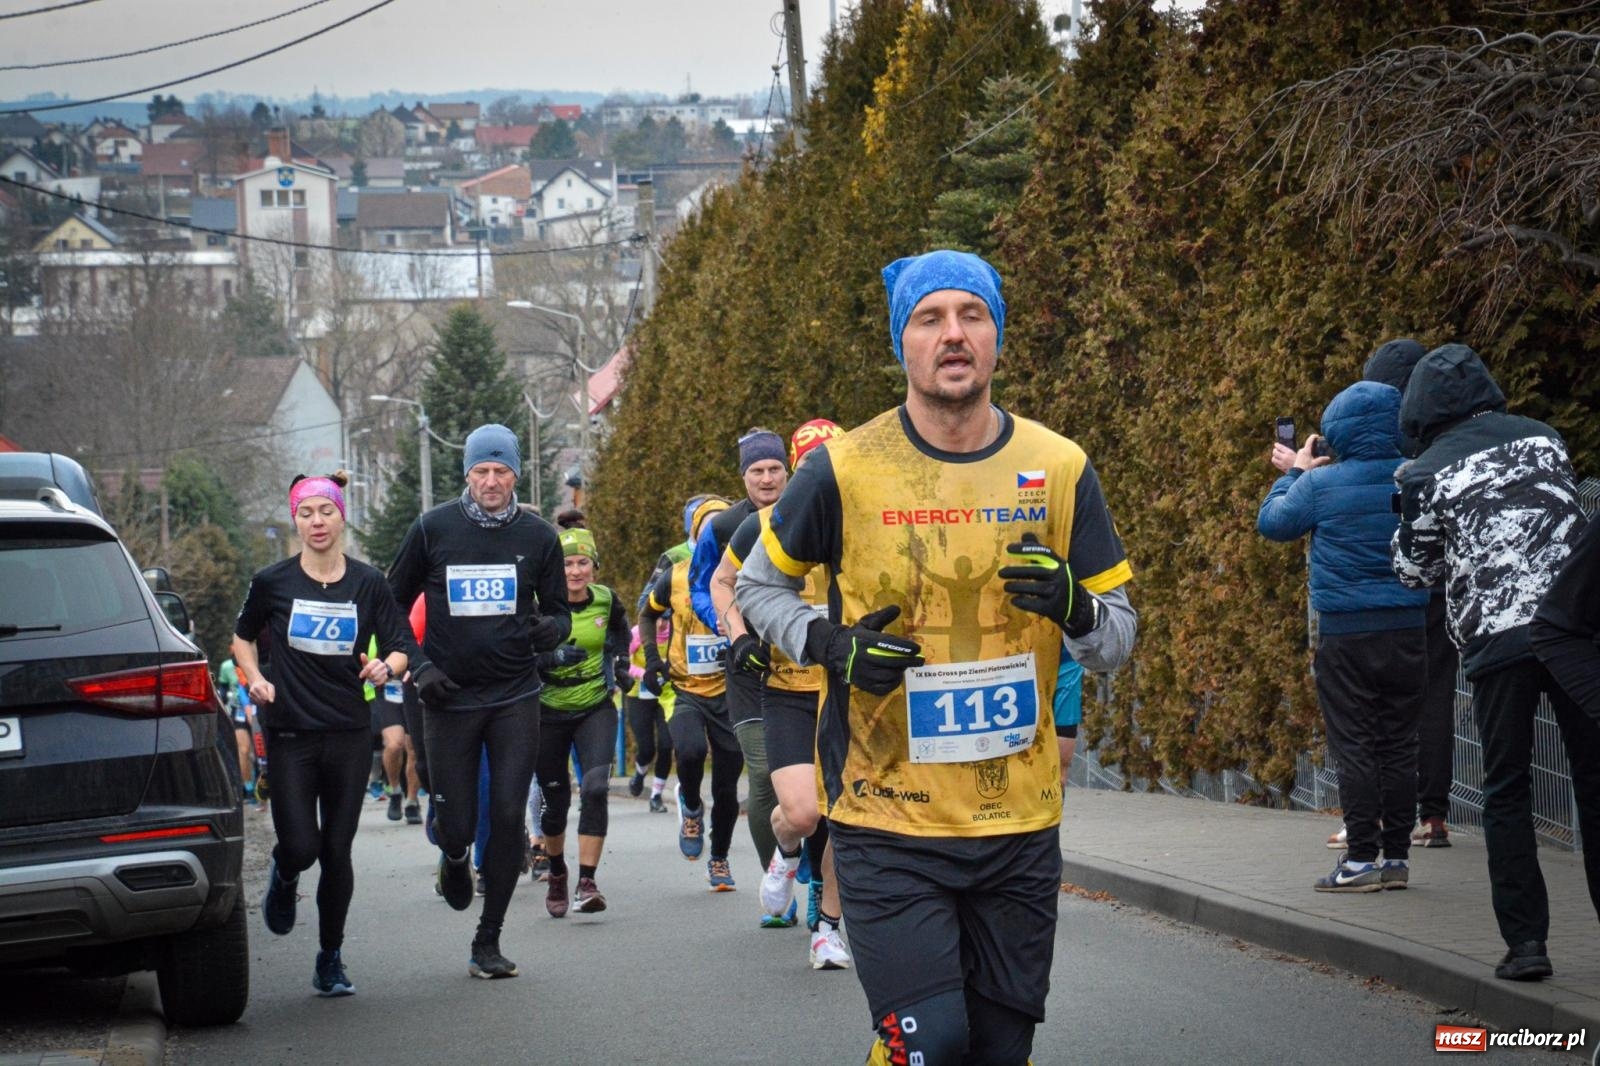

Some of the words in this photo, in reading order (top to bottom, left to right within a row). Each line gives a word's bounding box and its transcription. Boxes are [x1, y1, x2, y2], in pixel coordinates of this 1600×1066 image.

[882, 508, 974, 525] ENERGY
[982, 506, 1046, 523] TEAM
[461, 579, 505, 600] 188
[311, 616, 340, 640] 76
[924, 670, 937, 678] Eko
[938, 669, 958, 677] Cross
[958, 669, 968, 677] po
[968, 667, 988, 675] Ziemi
[988, 661, 1028, 673] Pietrowickiej
[934, 686, 1019, 732] 113
[980, 801, 1002, 811] OBEC
[972, 811, 1011, 822] BOLATICE
